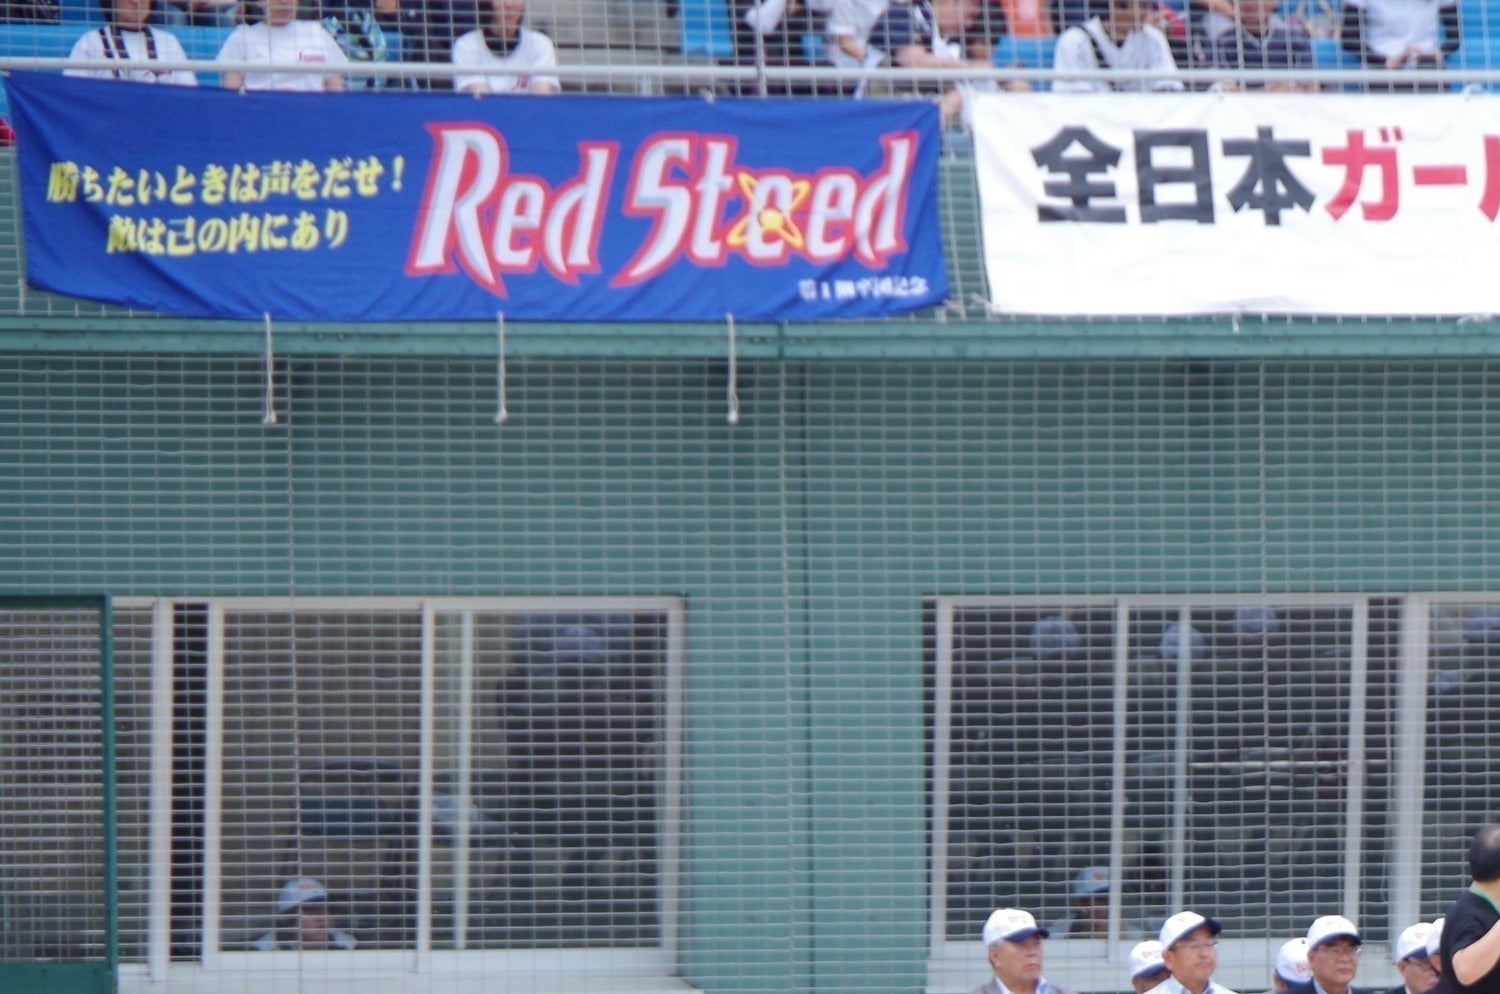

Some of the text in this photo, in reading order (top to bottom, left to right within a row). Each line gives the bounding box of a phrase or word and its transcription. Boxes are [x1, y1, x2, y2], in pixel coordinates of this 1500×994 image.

[106, 208, 349, 257] 敵は己の内にあり
[405, 121, 919, 299] Red Steed
